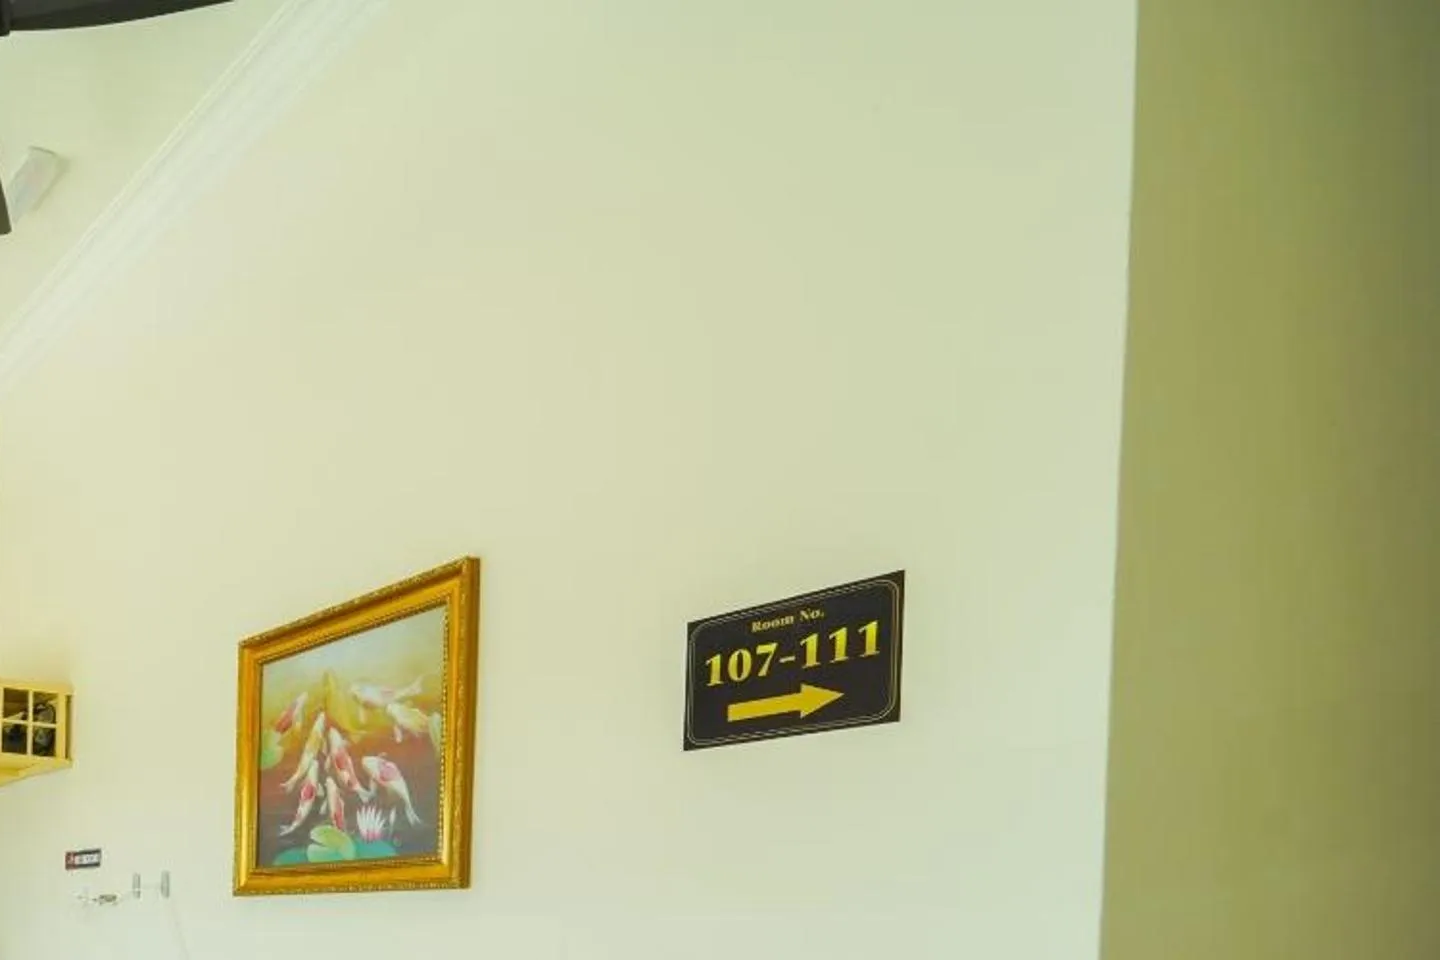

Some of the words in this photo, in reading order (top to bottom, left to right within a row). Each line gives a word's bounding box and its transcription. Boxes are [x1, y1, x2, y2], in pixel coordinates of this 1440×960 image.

[751, 615, 794, 633] Room
[800, 608, 825, 622] No.
[705, 620, 881, 688] 107-111
